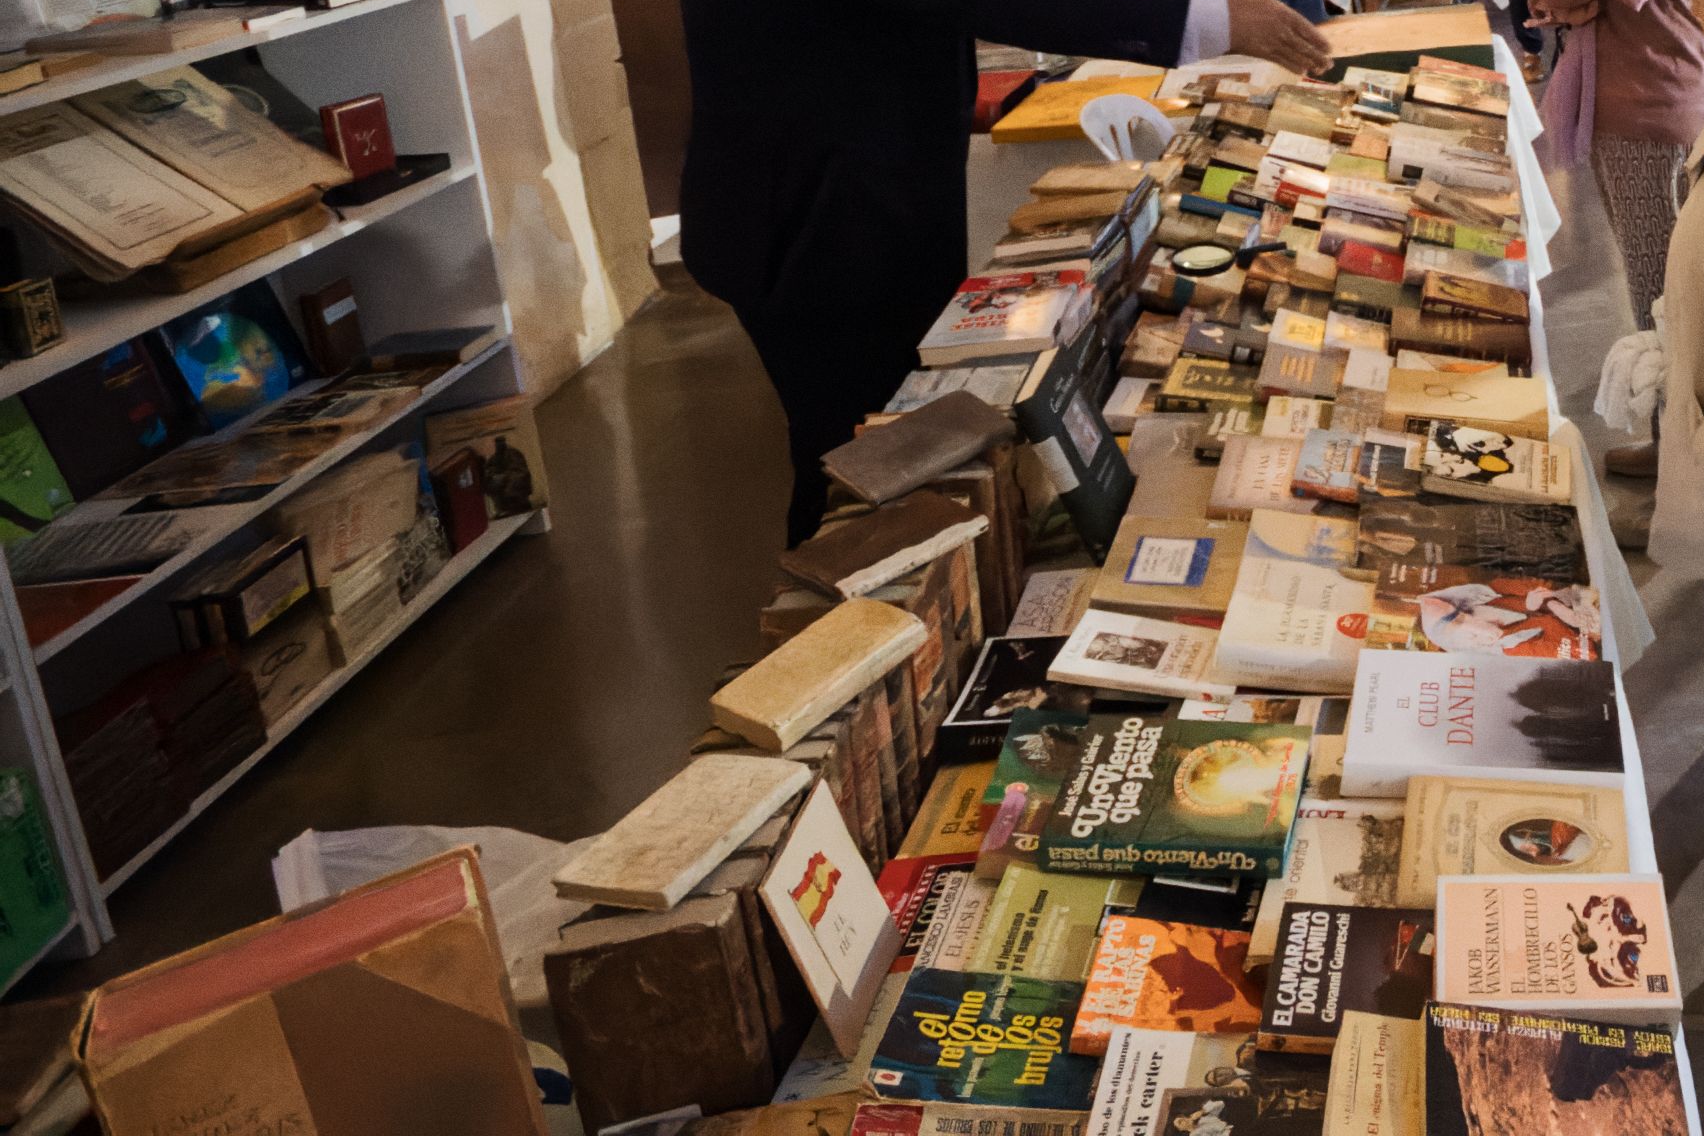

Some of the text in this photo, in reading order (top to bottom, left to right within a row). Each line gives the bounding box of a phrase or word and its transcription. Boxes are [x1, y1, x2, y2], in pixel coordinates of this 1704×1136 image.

[1396, 696, 1410, 709] EL
[1418, 682, 1440, 727] CLUB
[1447, 667, 1475, 745] DANTE
[1088, 717, 1144, 795] Viento
[1110, 726, 1164, 823] que pasa
[1048, 843, 1099, 861] pasa
[1103, 843, 1141, 863] que
[1143, 848, 1218, 869] Viento
[944, 945, 963, 958] EL
[995, 961, 1007, 971] el
[1092, 919, 1126, 983] RAPTO
[1295, 911, 1330, 1015] DON CAMILO
[1484, 888, 1501, 994] WASSERMANN
[1523, 888, 1542, 994] HOMBRECILLO
[1559, 933, 1577, 995] GANSOS
[1272, 911, 1311, 1026] EL CAMARADA
[1321, 913, 1351, 1023] Giovanni Guareschi
[1468, 948, 1484, 995] JAKOB
[1511, 978, 1526, 994] EL
[1543, 941, 1560, 994] DE LOS
[913, 1010, 950, 1039] el
[936, 990, 987, 1068] retorno
[971, 1023, 1004, 1054] de
[997, 1014, 1037, 1051] los
[1506, 1025, 1562, 1042] ALIANZA
[1013, 1016, 1064, 1085] brujos
[1111, 1032, 1132, 1087] diamantes
[1106, 1089, 1118, 1104] los
[1141, 1051, 1164, 1109] carter
[1102, 1106, 1112, 1120] de
